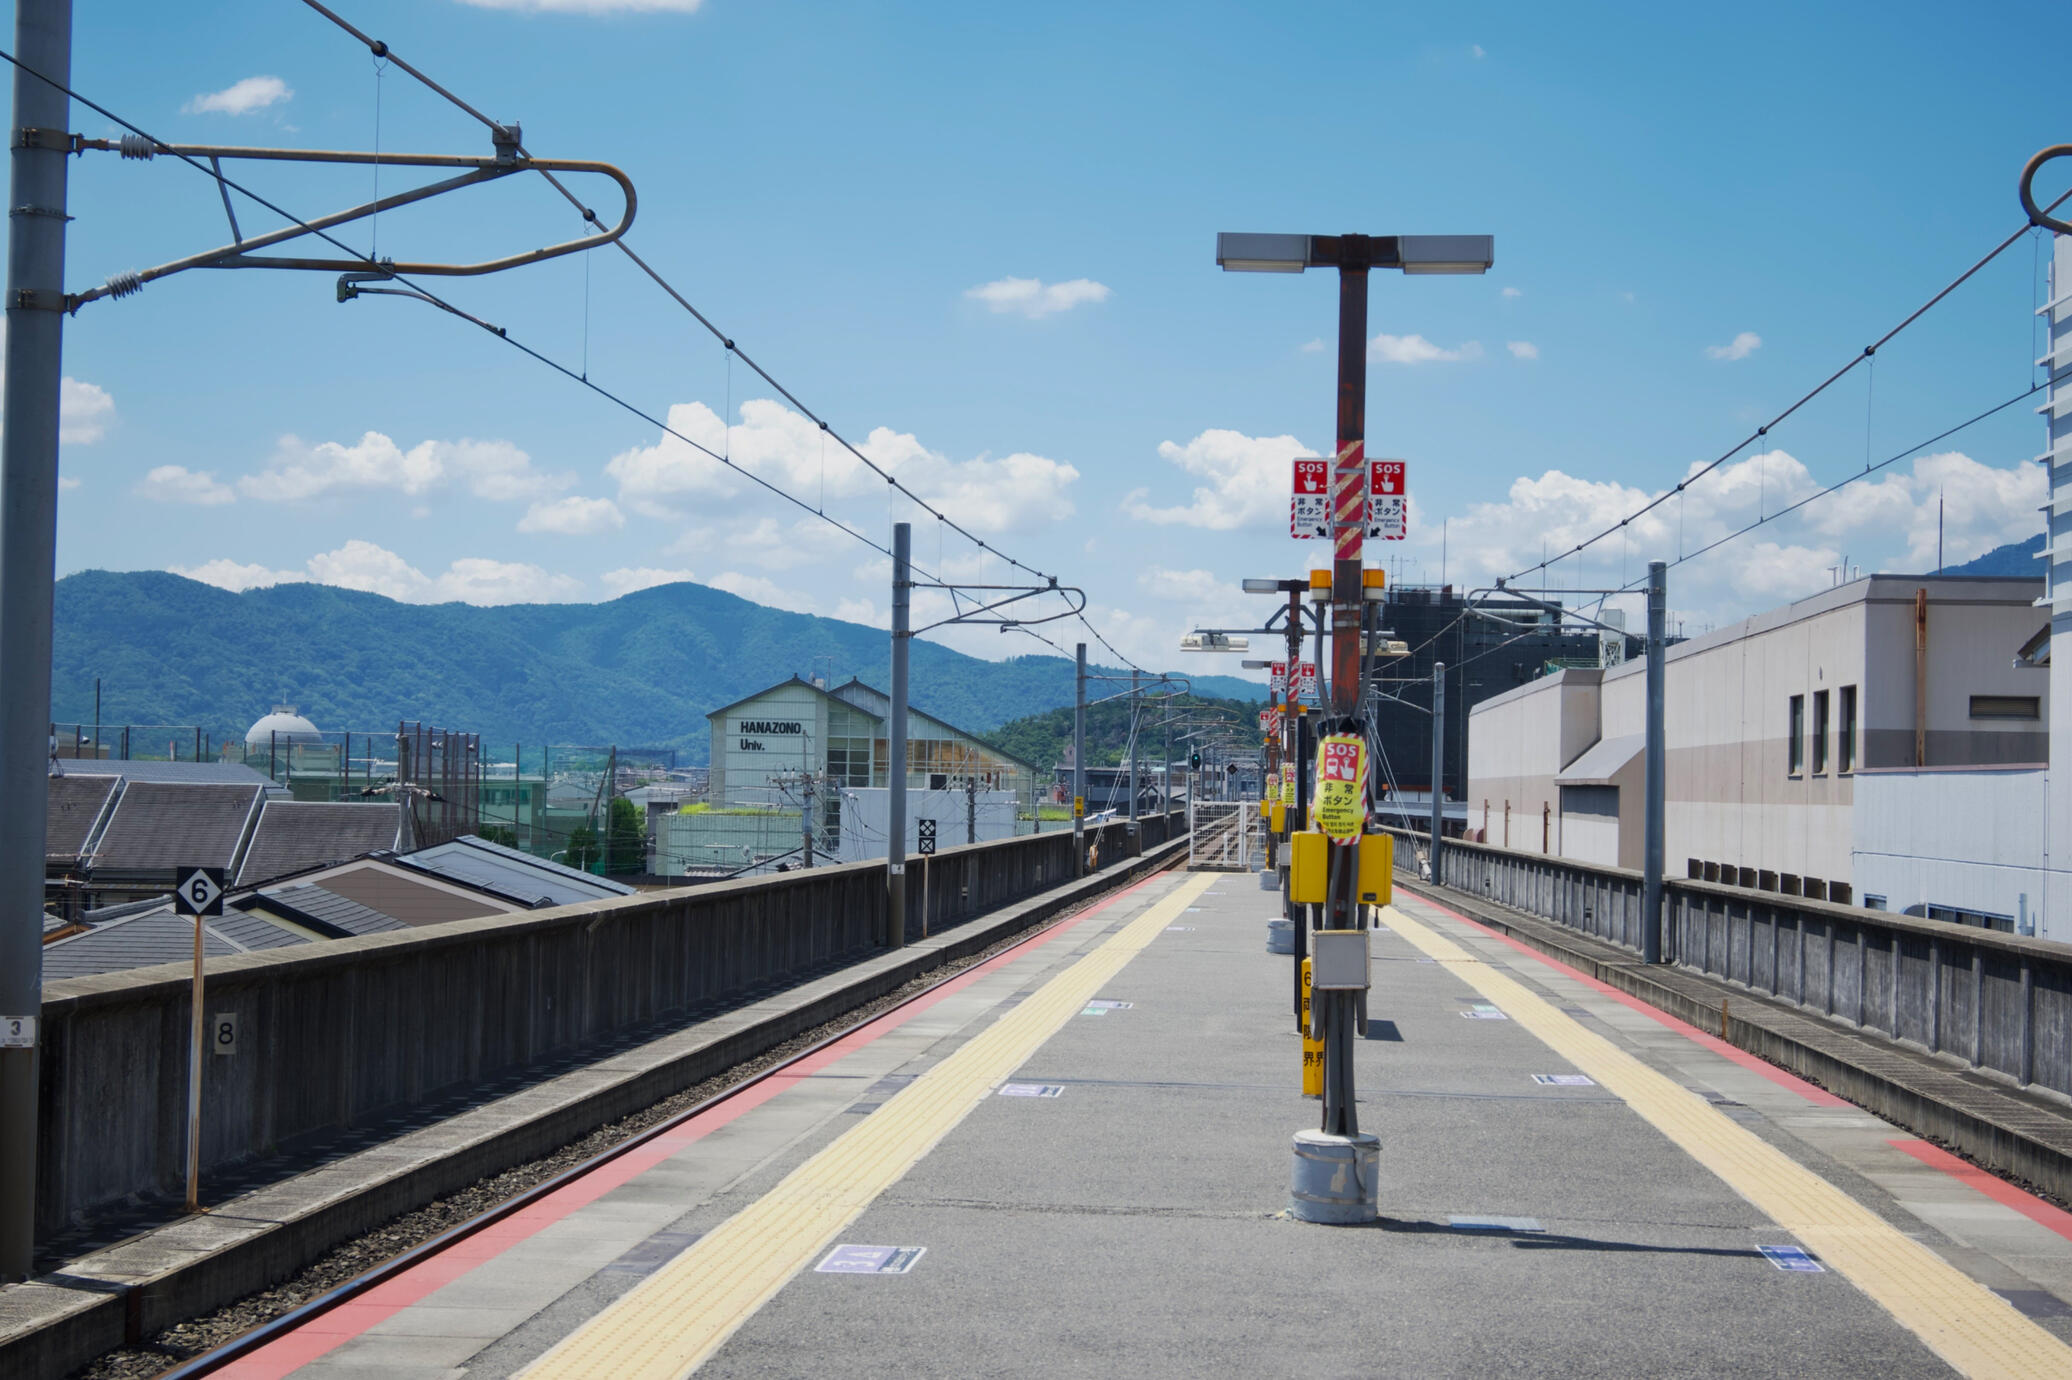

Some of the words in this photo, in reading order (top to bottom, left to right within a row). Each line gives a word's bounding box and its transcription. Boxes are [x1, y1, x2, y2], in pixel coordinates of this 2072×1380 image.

[1298, 463, 1324, 473] SOS
[1375, 464, 1401, 474] SOS
[1297, 498, 1324, 506] 非常
[1375, 499, 1401, 507] 非常
[1297, 507, 1322, 516] ボタン
[1375, 508, 1401, 516] ボタン
[740, 721, 801, 734] HANAZONO
[740, 738, 766, 751] Univ.
[1327, 743, 1357, 757] SOS
[1324, 782, 1354, 795] 非常
[1323, 795, 1353, 806] ボタン
[1322, 807, 1354, 815] Emergency
[191, 879, 209, 904] 6
[11, 1020, 22, 1036] 3
[218, 1022, 234, 1045] 8
